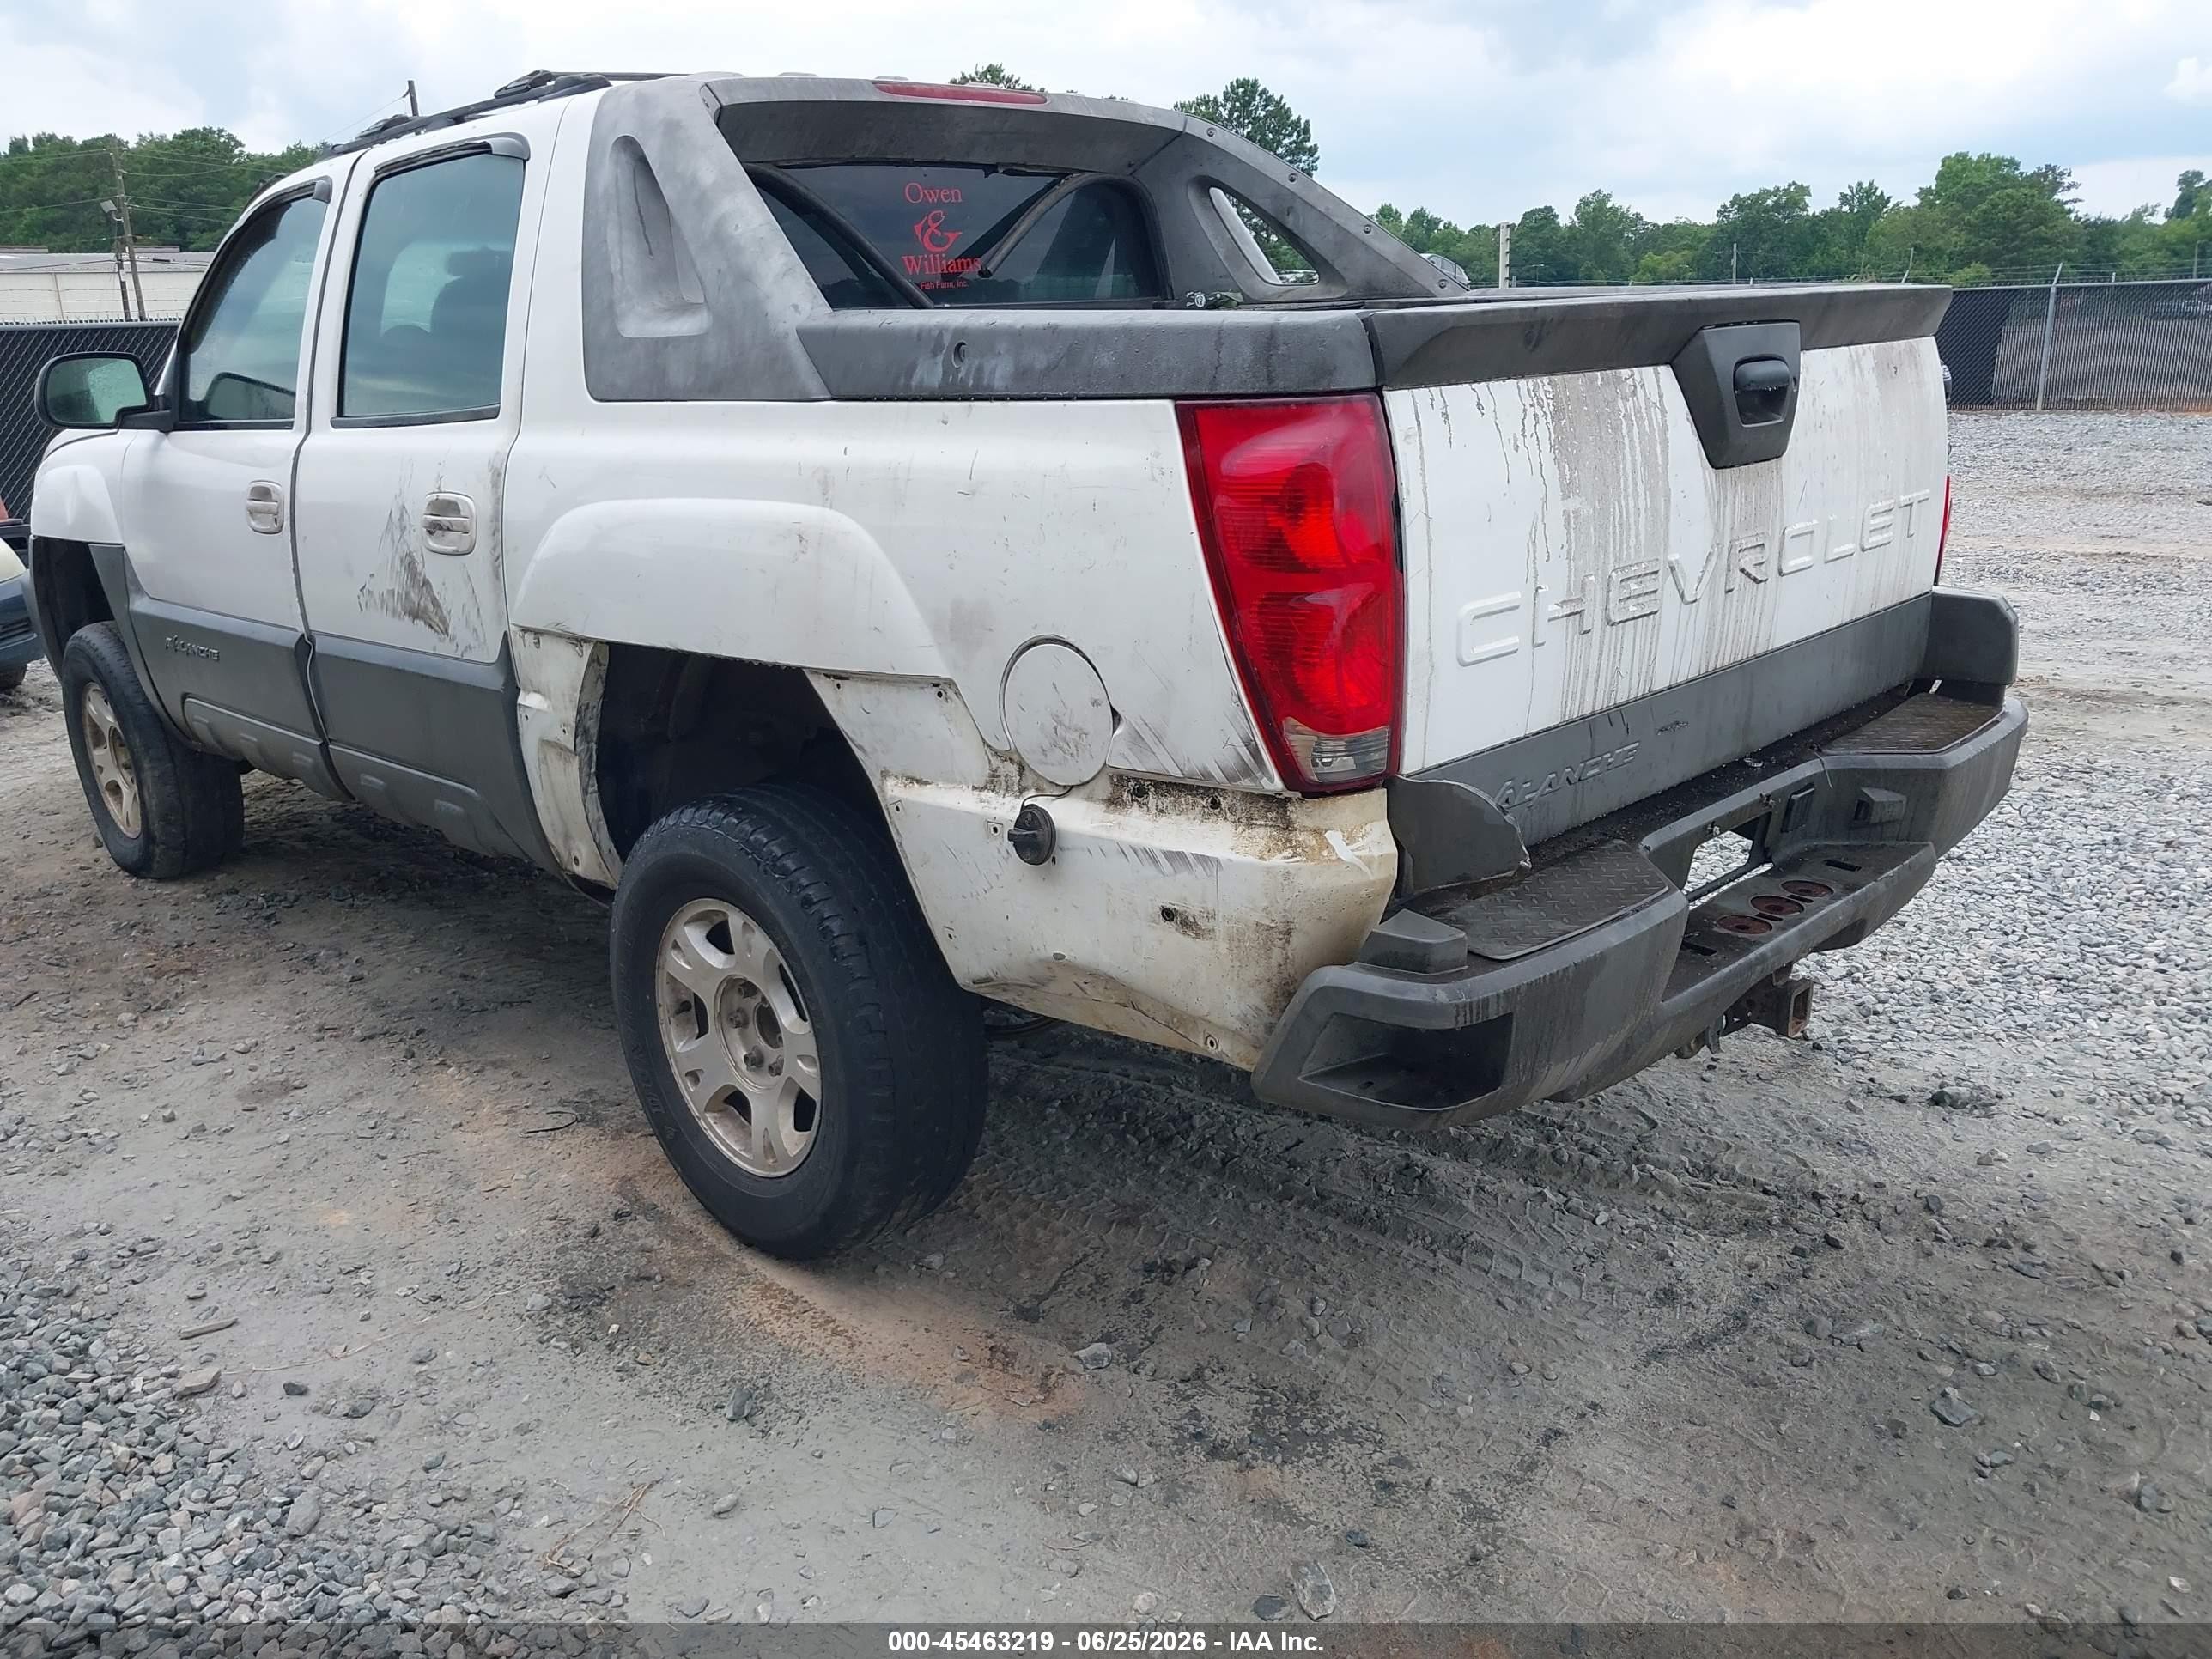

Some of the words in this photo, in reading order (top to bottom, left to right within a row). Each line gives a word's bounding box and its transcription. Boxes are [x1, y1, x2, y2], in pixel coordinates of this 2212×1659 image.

[905, 182, 963, 204] Owen
[902, 255, 982, 276] Williams
[957, 279, 969, 288] Inc.
[1456, 489, 1930, 667] CHEVROLET
[1492, 741, 1641, 809] ALANCHE
